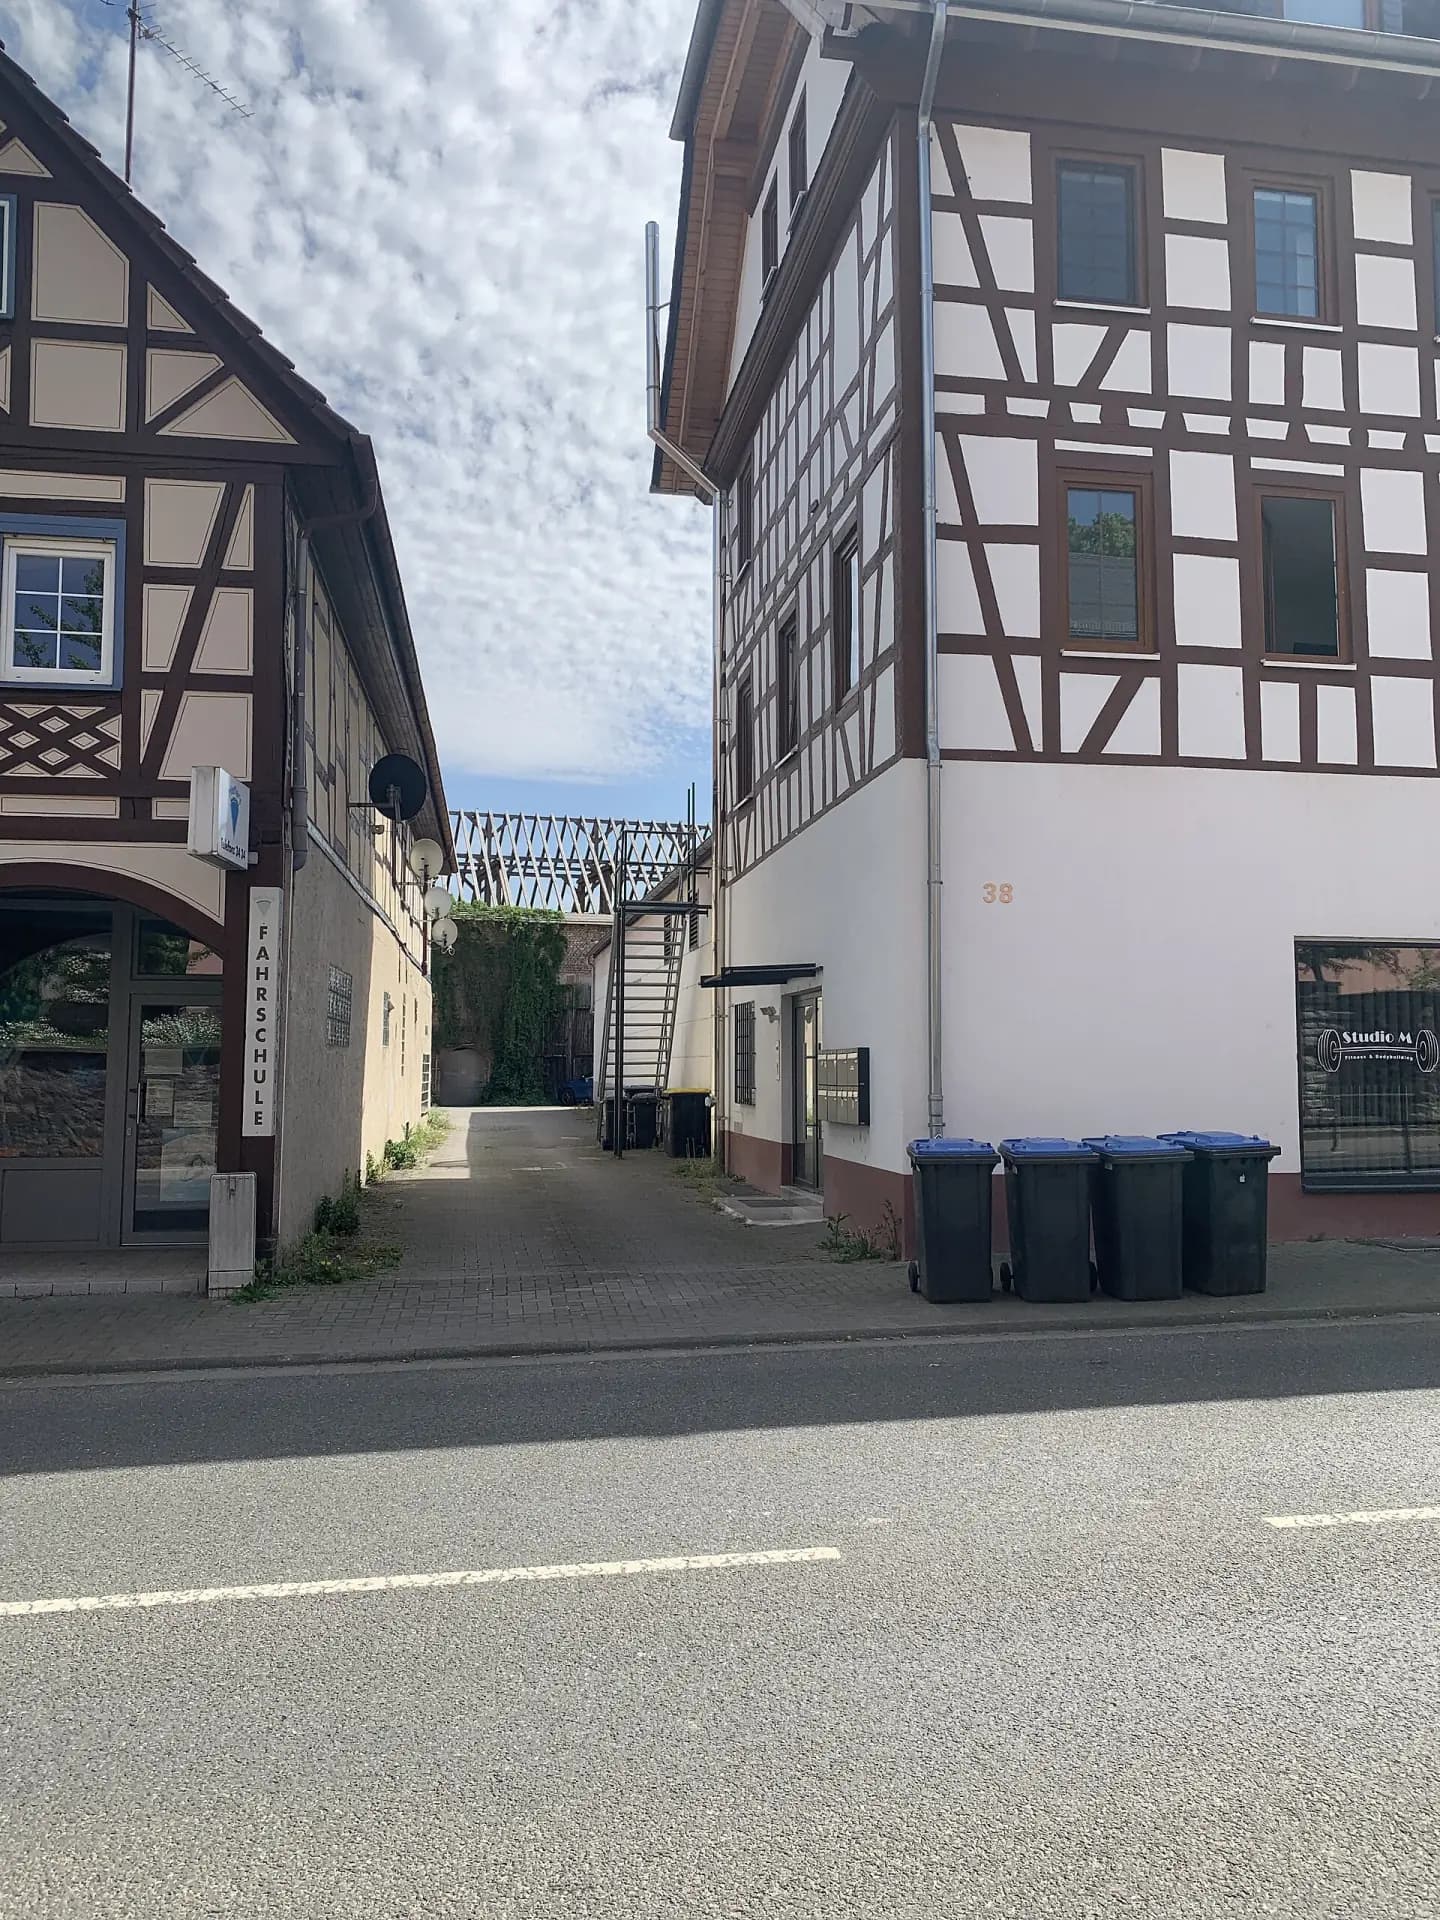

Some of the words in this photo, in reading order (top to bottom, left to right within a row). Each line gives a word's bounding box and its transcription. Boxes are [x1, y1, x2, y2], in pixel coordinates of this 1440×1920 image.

[982, 882, 1013, 903] 38
[253, 925, 270, 1126] FAHRSCHULE
[1342, 1030, 1395, 1044] Studio
[1398, 1031, 1413, 1044] M
